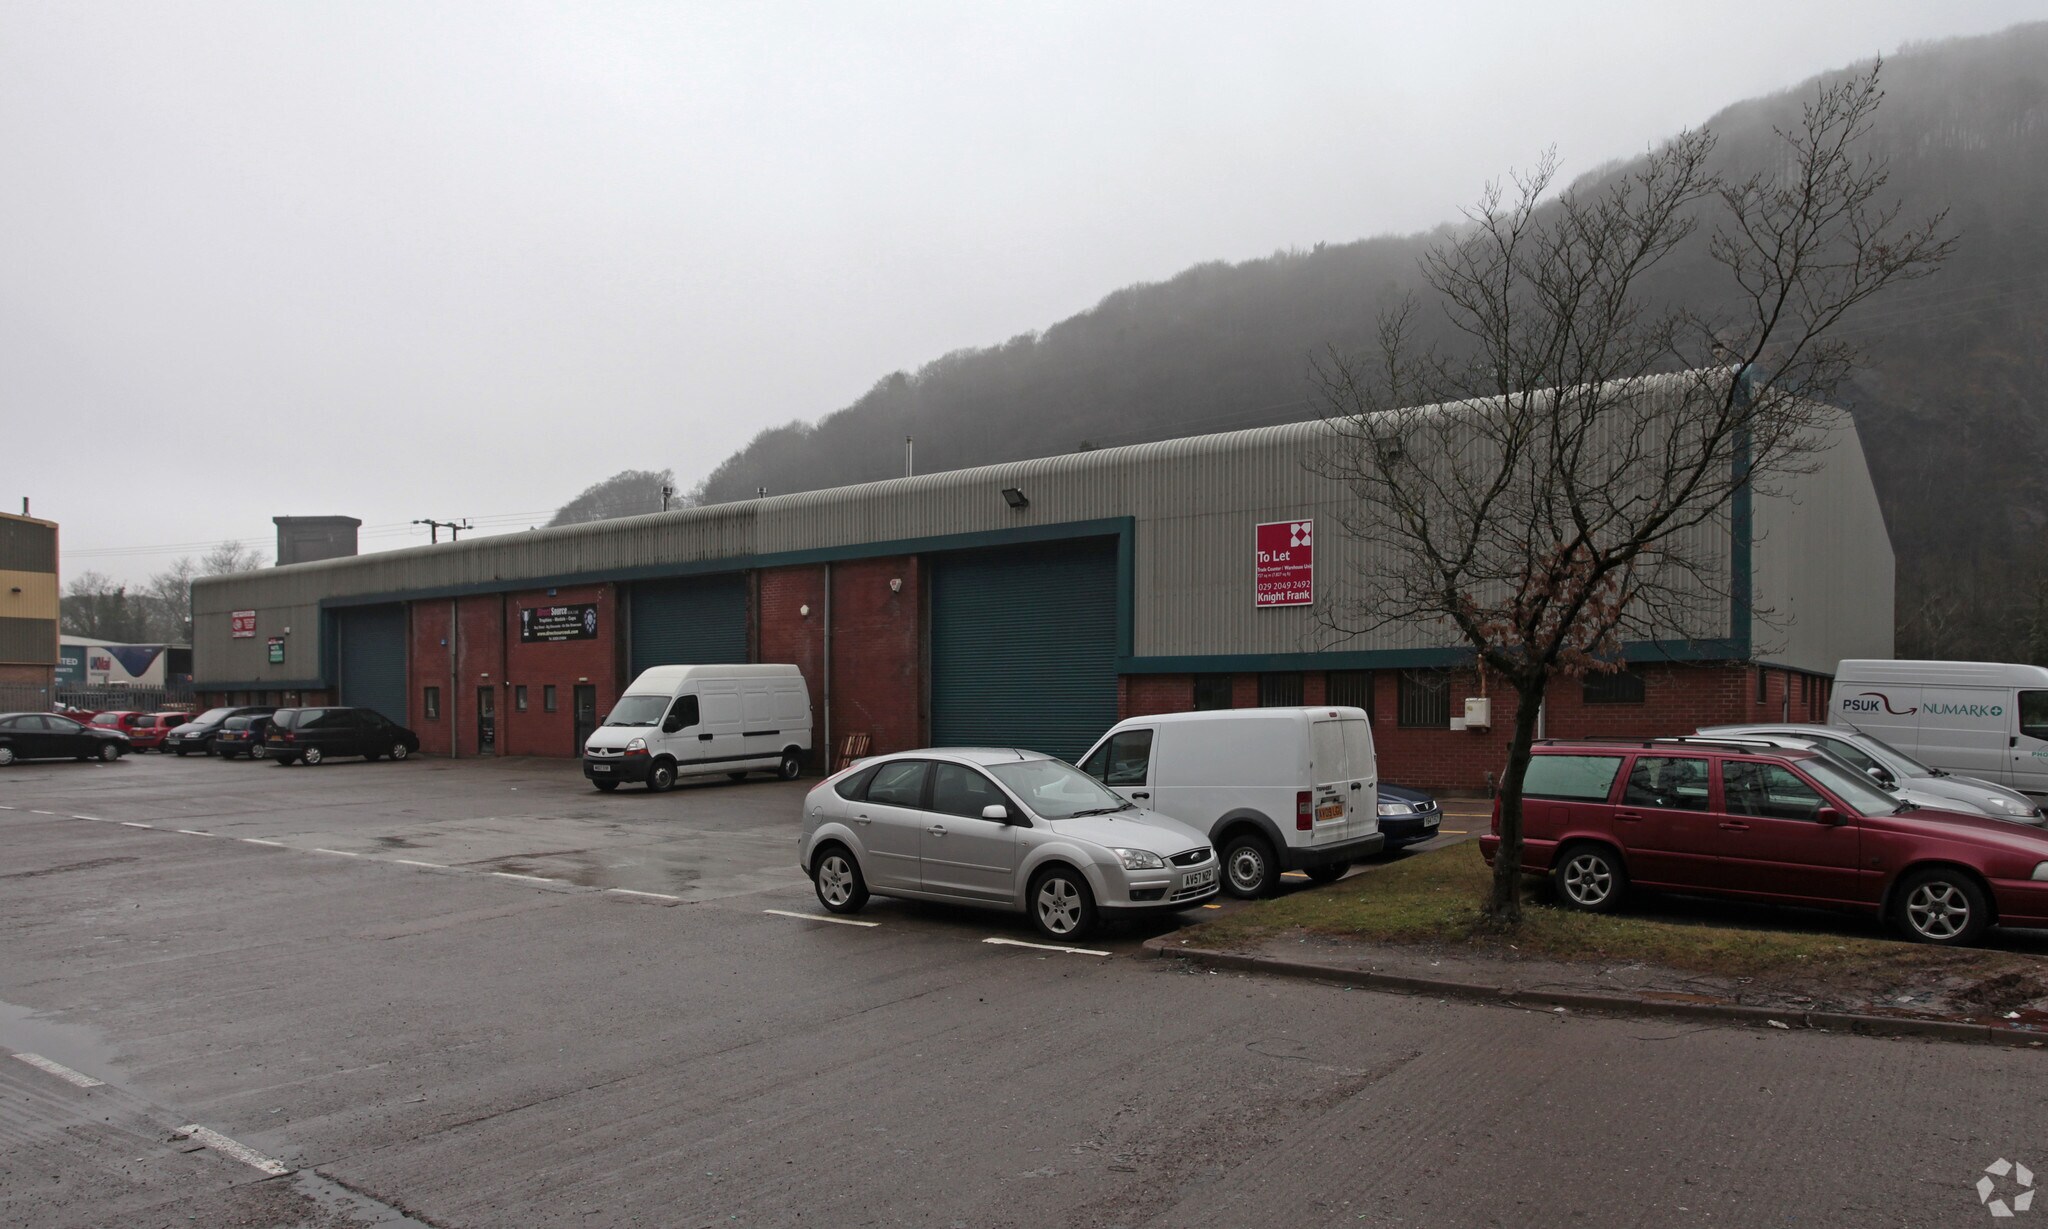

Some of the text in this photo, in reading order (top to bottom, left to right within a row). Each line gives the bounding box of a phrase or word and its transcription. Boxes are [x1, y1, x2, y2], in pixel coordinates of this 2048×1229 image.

[1257, 550, 1290, 562] To Let
[1258, 580, 1310, 591] 029 2049 2492
[1258, 590, 1310, 603] Knight Frank
[551, 607, 568, 616] Source
[1842, 699, 1880, 711] PSUK
[1922, 703, 1989, 717] NUMARK
[1185, 872, 1201, 886] AV57
